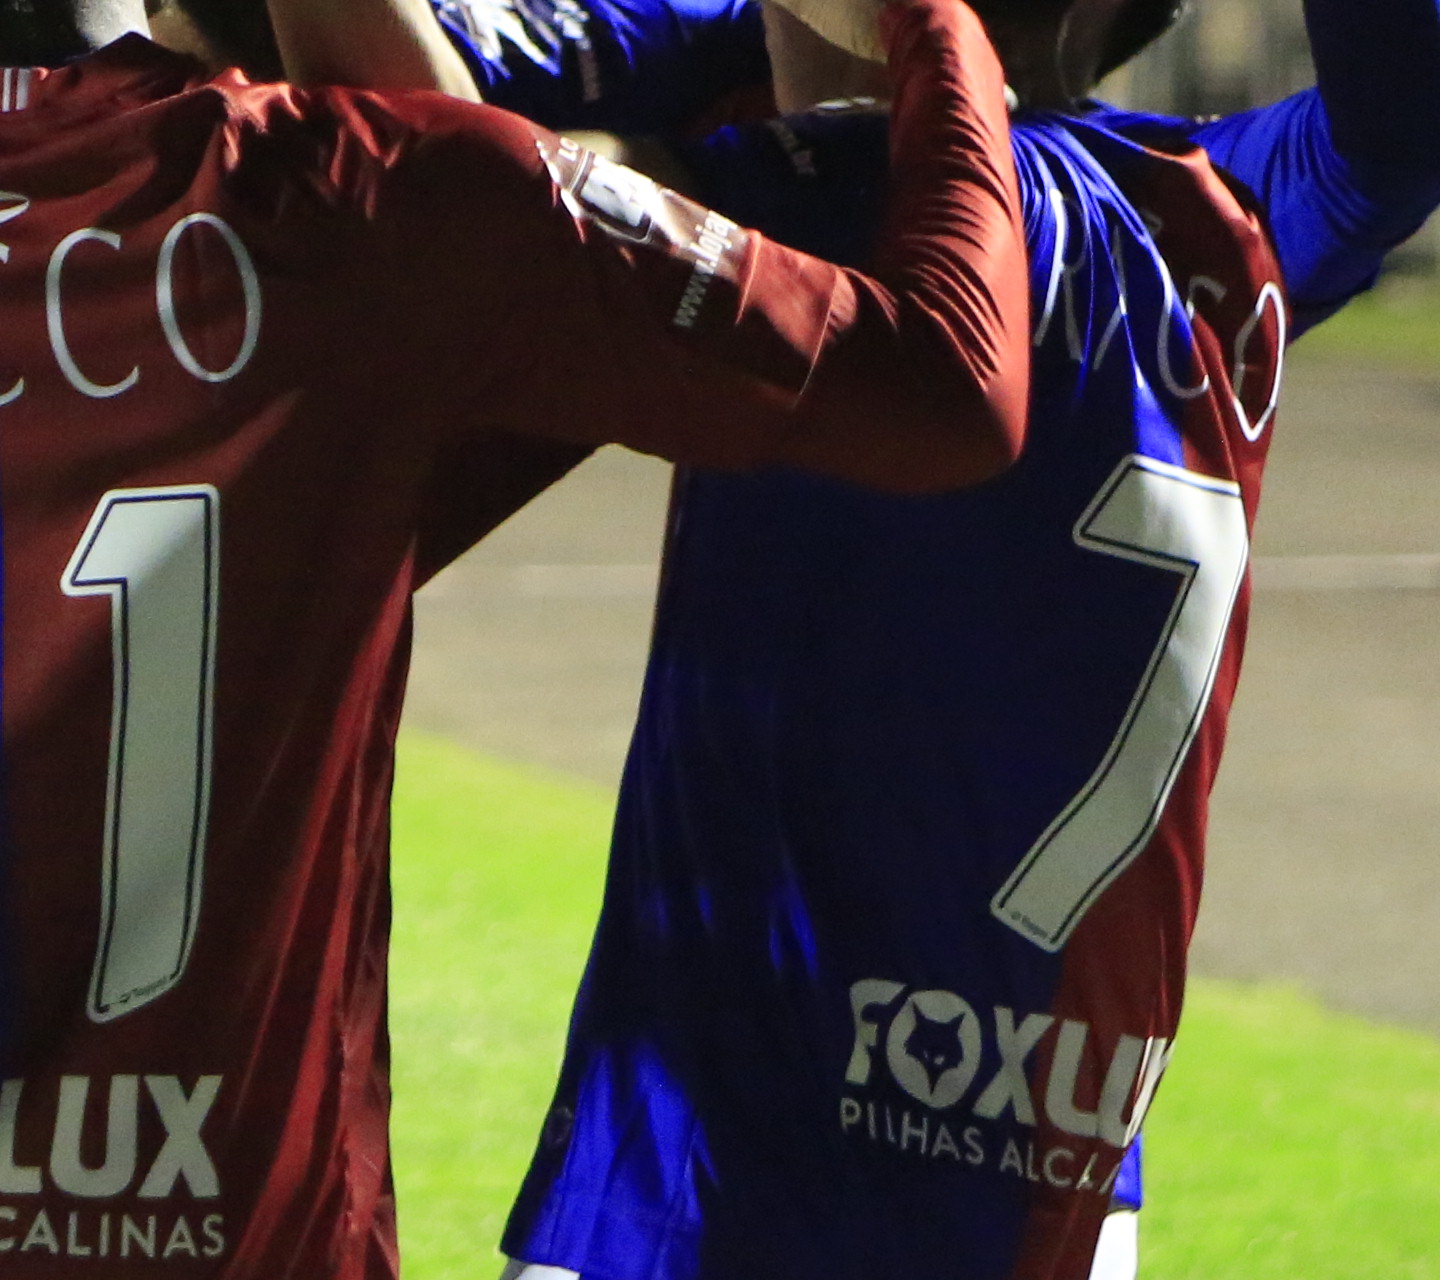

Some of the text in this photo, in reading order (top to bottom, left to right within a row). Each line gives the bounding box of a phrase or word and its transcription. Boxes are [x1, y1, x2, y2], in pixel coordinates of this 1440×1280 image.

[989, 453, 1250, 954] 7
[838, 1096, 985, 1166] PILHAS
[844, 977, 1176, 1149] FOXLU
